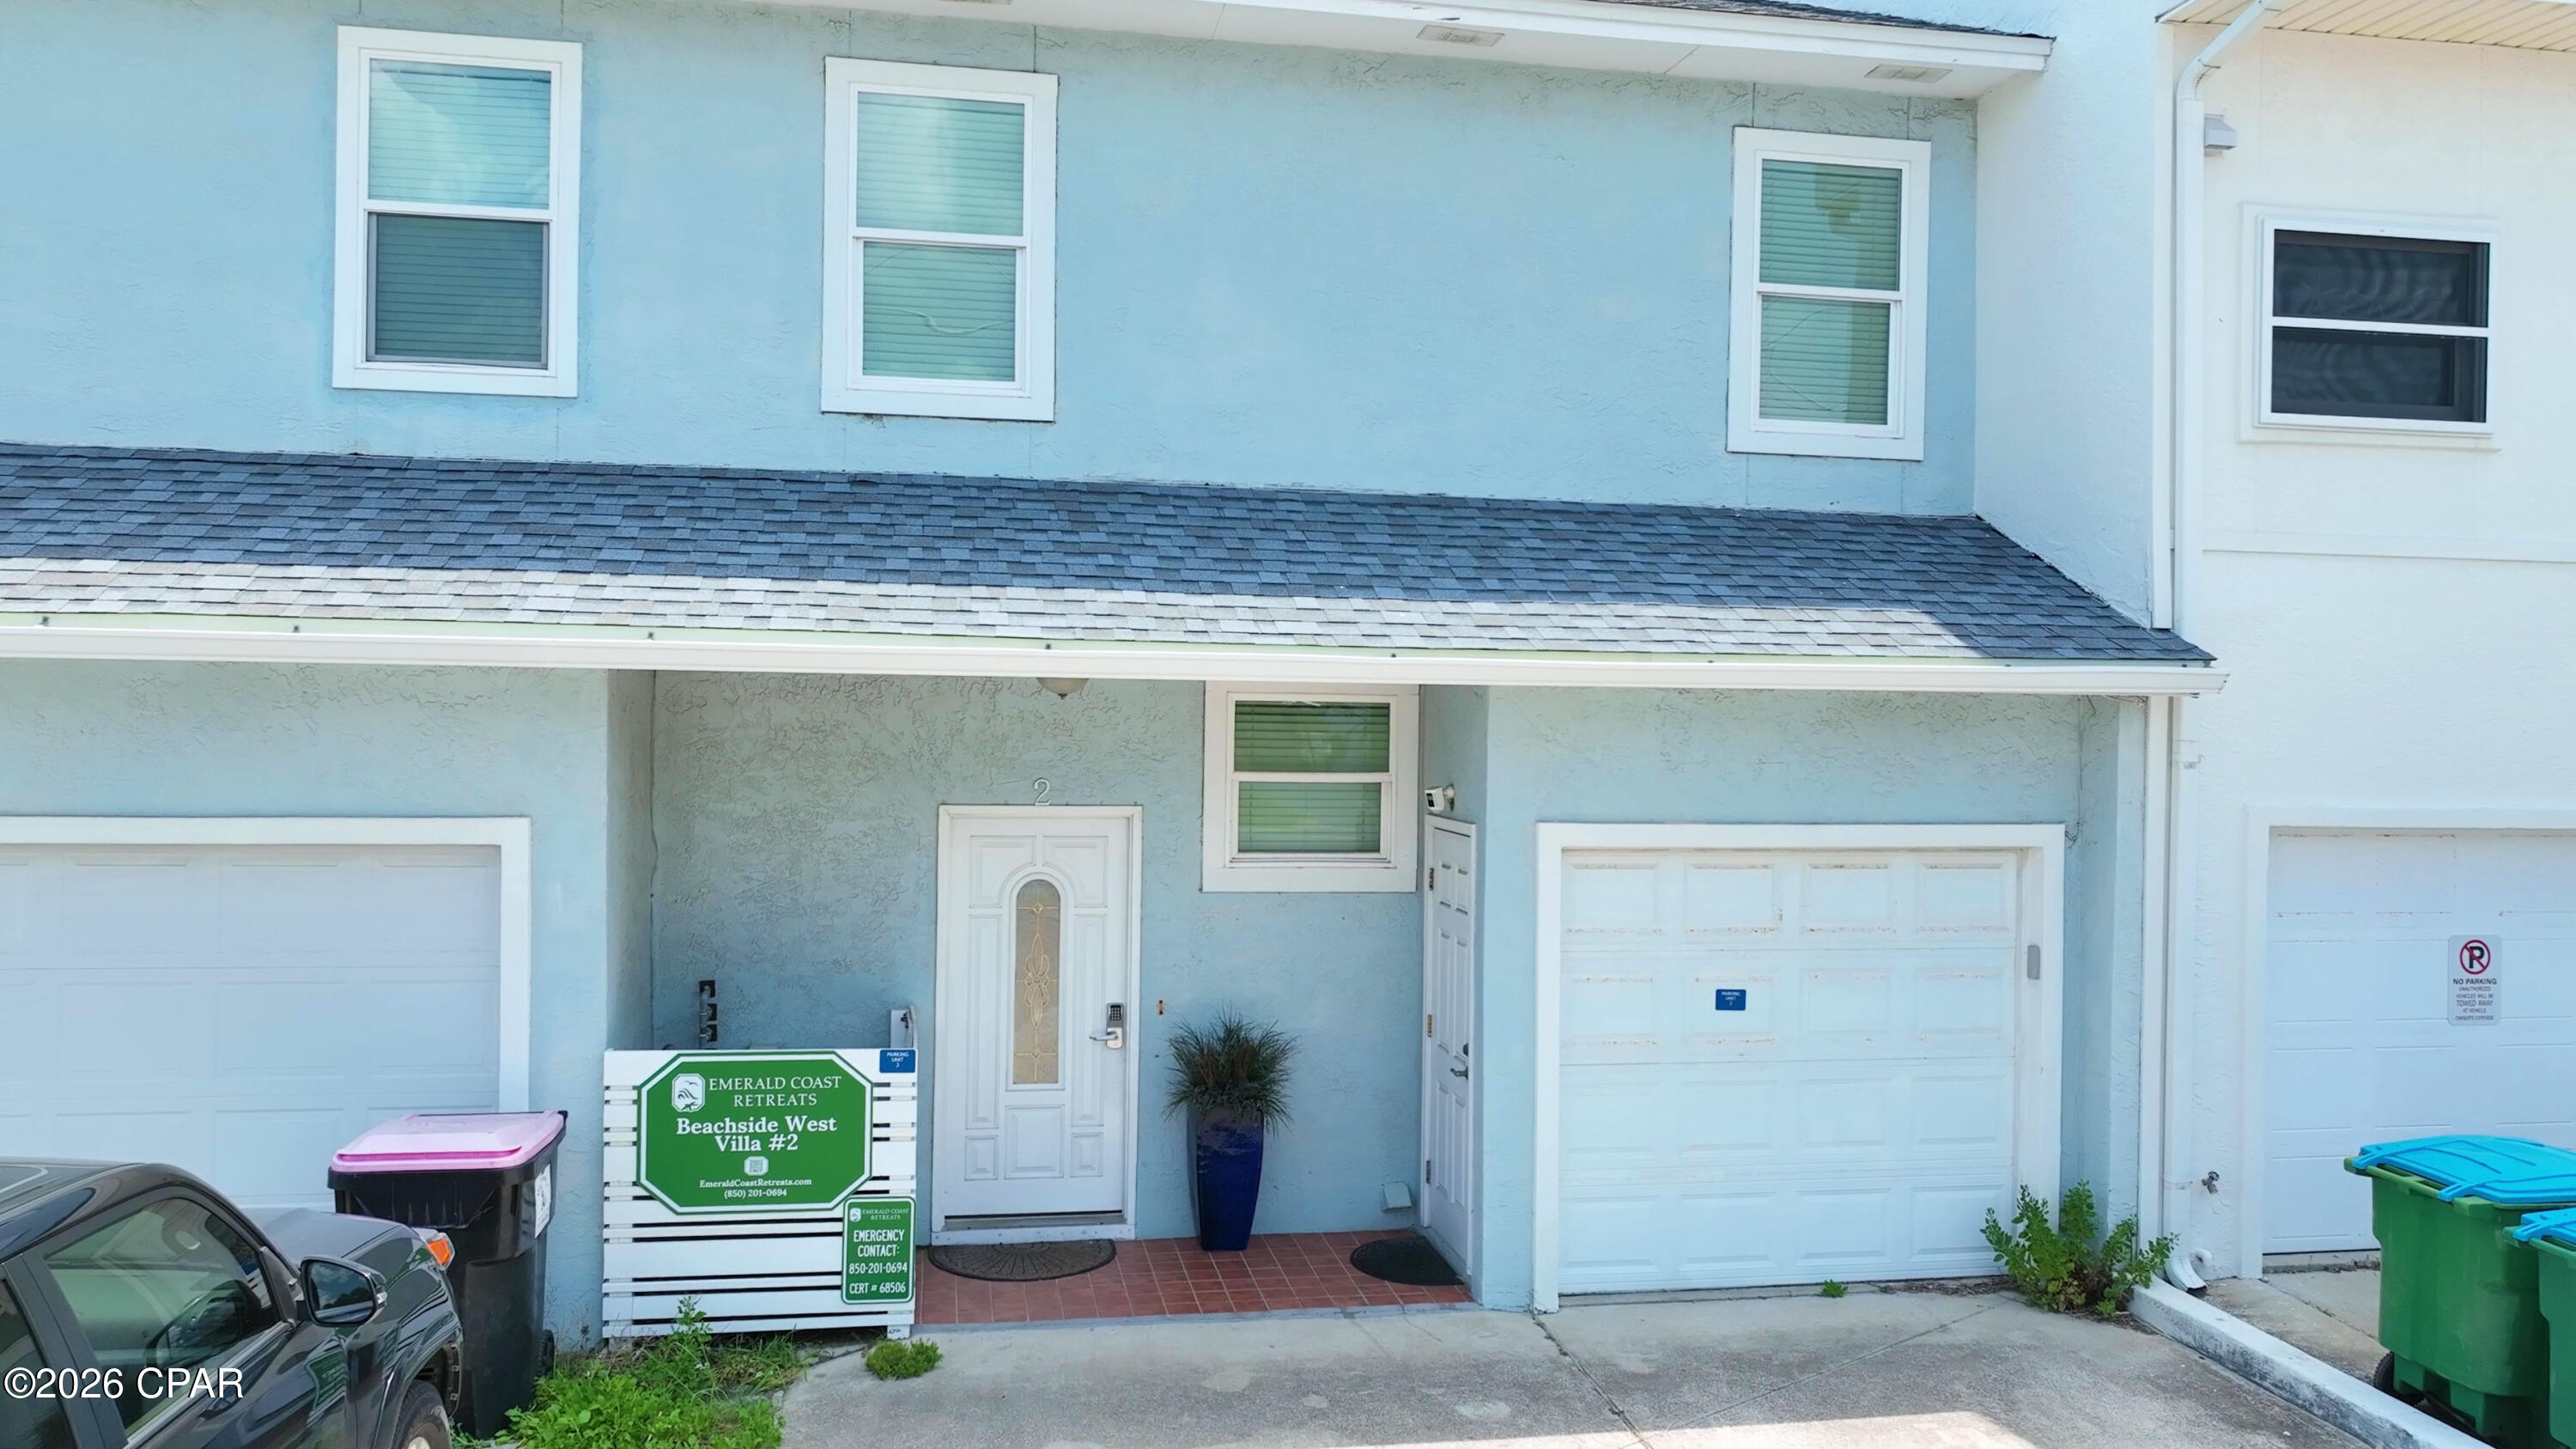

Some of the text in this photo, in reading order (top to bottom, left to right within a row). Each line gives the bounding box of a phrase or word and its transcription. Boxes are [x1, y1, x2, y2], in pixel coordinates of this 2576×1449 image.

[1033, 777, 1051, 806] 2
[709, 1076, 842, 1091] EMERALD COAST
[733, 1093, 817, 1107] RETREATS
[676, 1115, 837, 1135] Beachside West
[714, 1134, 799, 1152] Villa #2
[699, 1178, 812, 1189] EmeraldCoastRetreats.com
[724, 1189, 787, 1199] (850) 201-0694
[854, 1229, 905, 1243] EMERGENCY
[857, 1245, 900, 1257] CONTACT:
[848, 1262, 908, 1275] 850-201-0694
[849, 1282, 869, 1294] CERT
[879, 1282, 906, 1294] 68506
